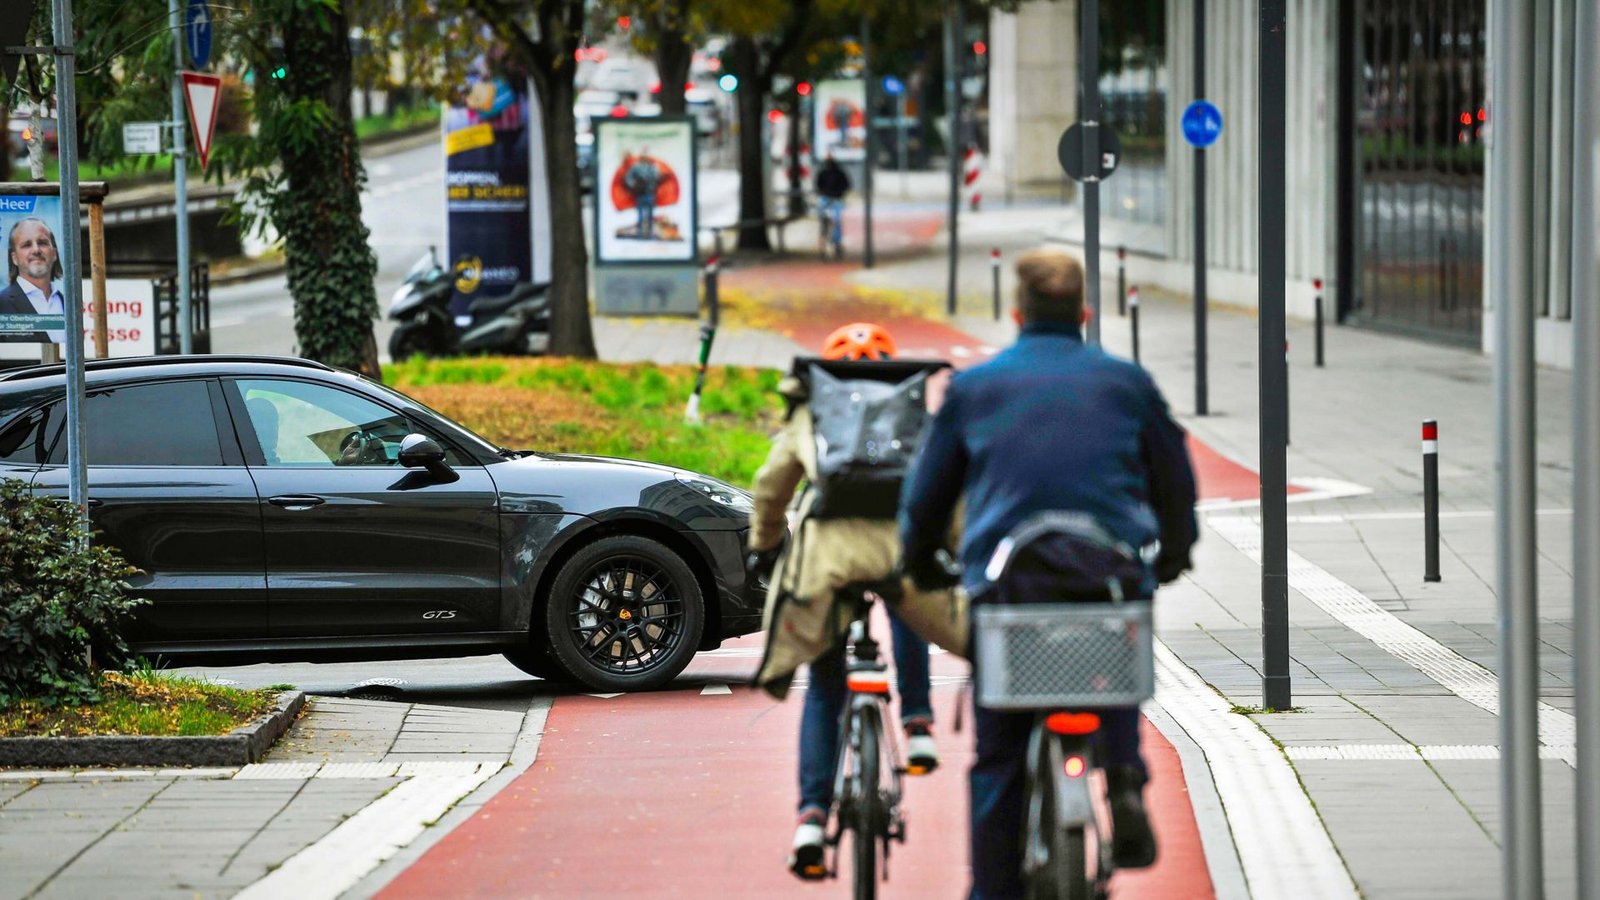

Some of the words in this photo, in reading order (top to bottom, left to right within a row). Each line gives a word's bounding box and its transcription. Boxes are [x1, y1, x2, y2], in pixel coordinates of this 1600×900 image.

[0, 198, 31, 210] Heer
[6, 322, 35, 331] Stuttgart
[422, 610, 457, 619] GTS
